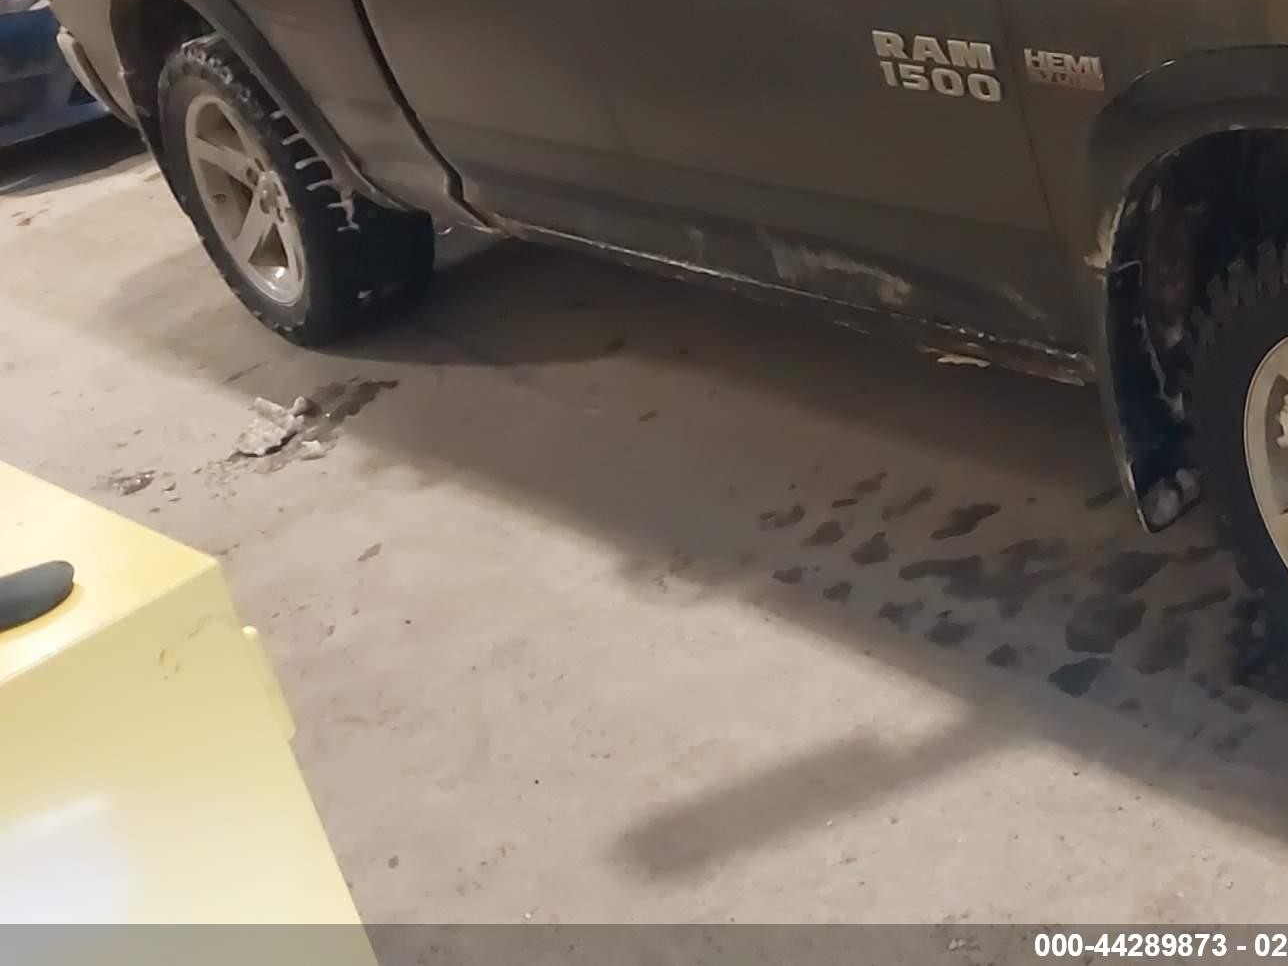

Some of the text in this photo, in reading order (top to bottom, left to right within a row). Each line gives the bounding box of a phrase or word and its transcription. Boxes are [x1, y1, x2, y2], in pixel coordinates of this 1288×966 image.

[871, 29, 997, 71] RAM
[1023, 47, 1103, 76] HEMI
[879, 61, 1002, 102] 1500
